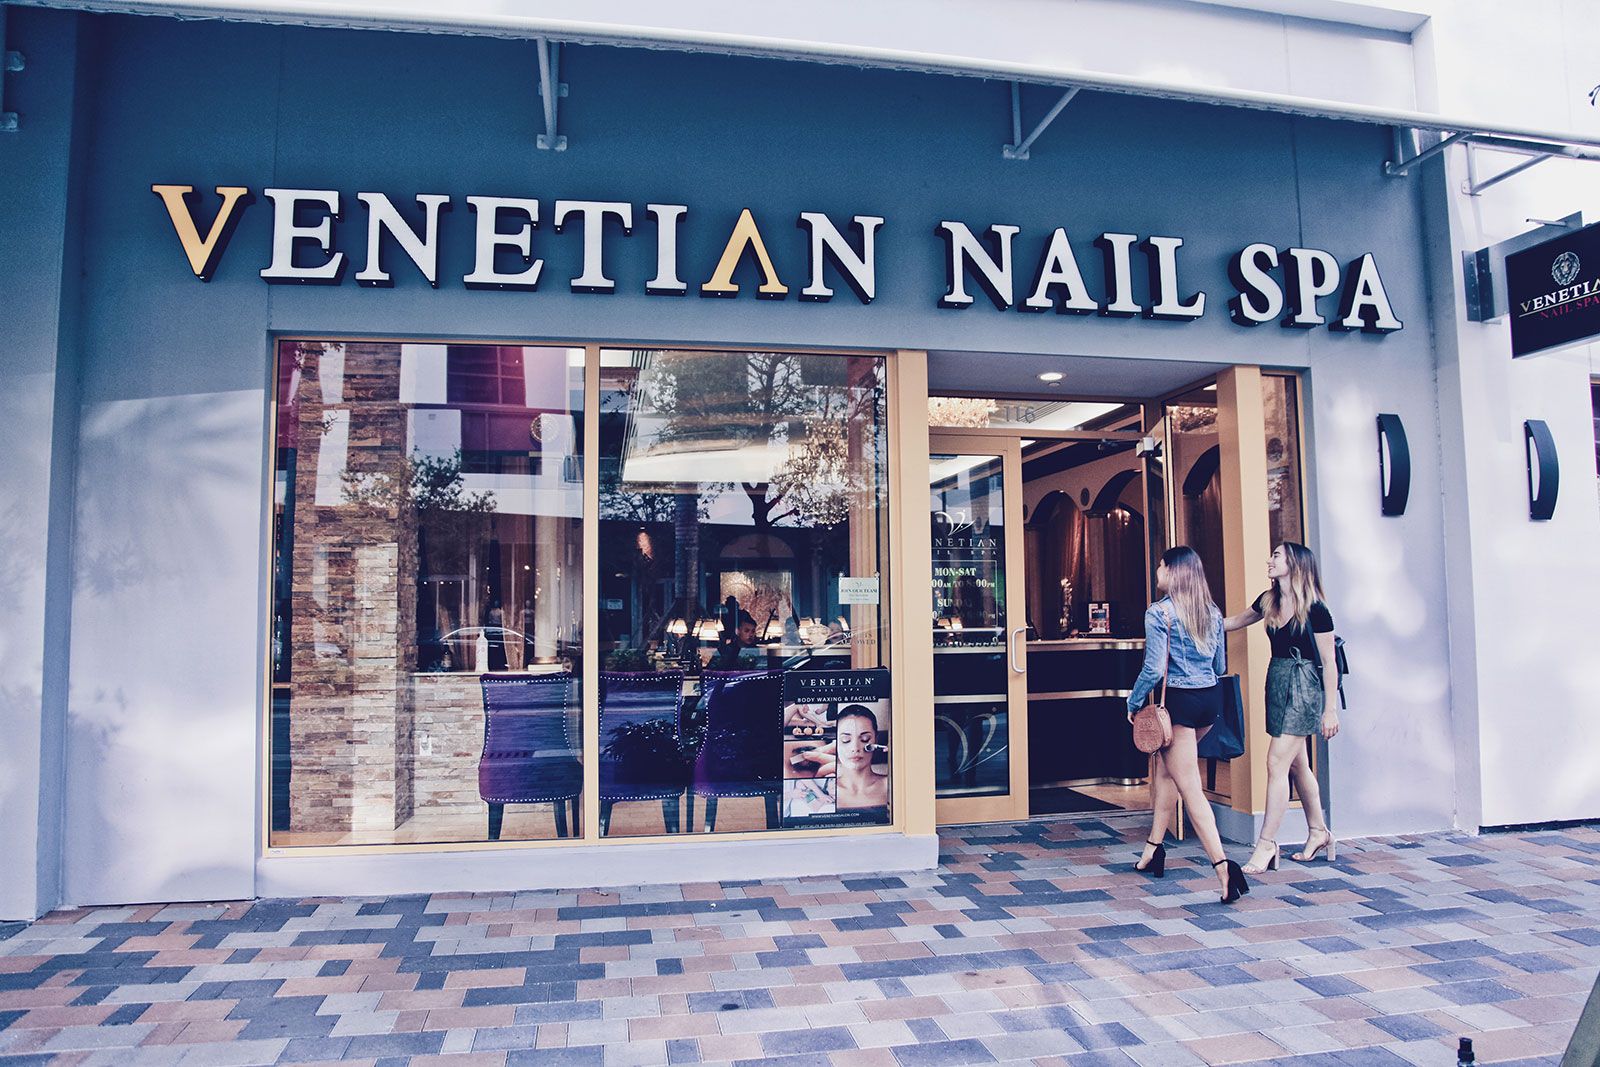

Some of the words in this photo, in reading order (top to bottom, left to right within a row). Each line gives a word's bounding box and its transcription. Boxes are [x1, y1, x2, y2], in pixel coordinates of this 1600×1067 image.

[150, 184, 886, 303] VENETIAN
[934, 220, 1207, 317] NAIL
[1230, 243, 1404, 332] SPA
[1520, 278, 1600, 313] VENETIA
[1539, 304, 1573, 318] NAIL
[1576, 294, 1600, 310] SPA
[935, 538, 997, 547] NETIAN
[800, 677, 872, 686] VENETIAN
